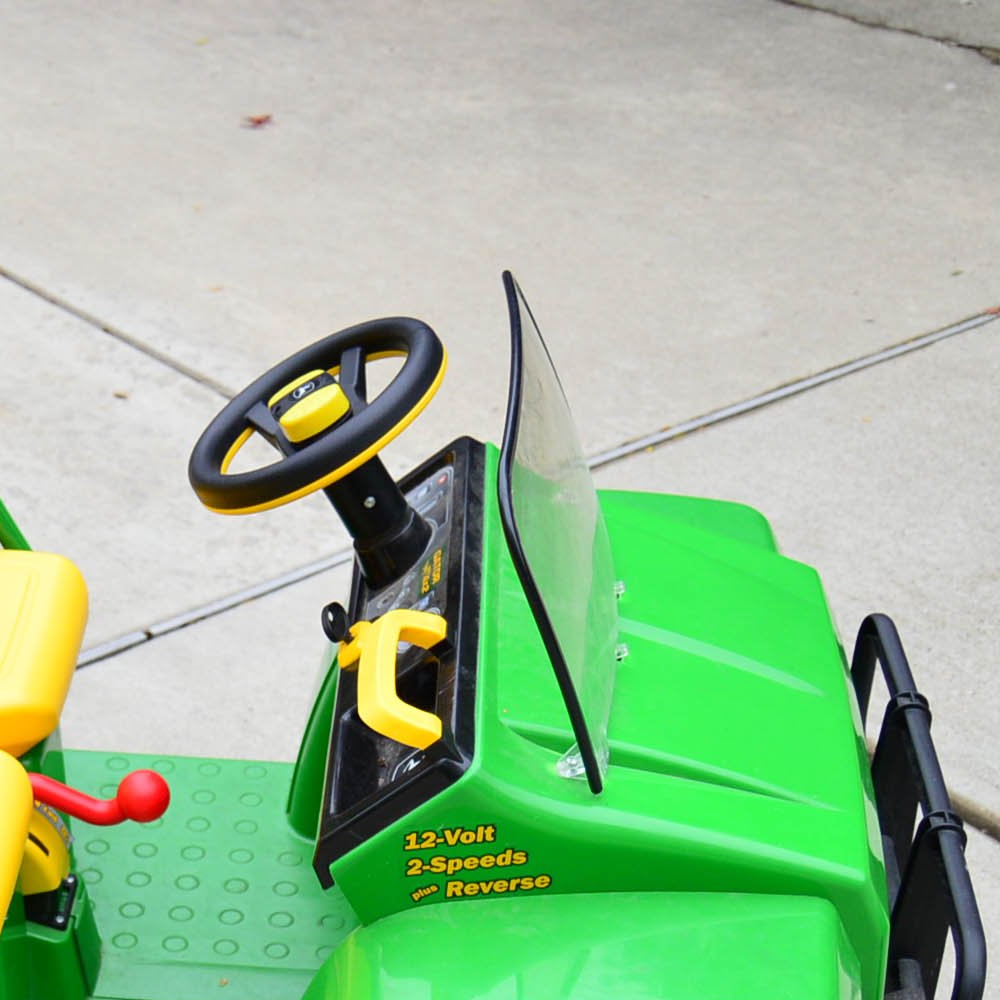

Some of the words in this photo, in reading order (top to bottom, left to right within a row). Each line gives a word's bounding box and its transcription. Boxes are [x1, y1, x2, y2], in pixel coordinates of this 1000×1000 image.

[404, 825, 496, 851] 12-Volt
[406, 849, 528, 876] 2-Speeds
[411, 884, 440, 902] plus
[446, 874, 552, 899] Reverse
